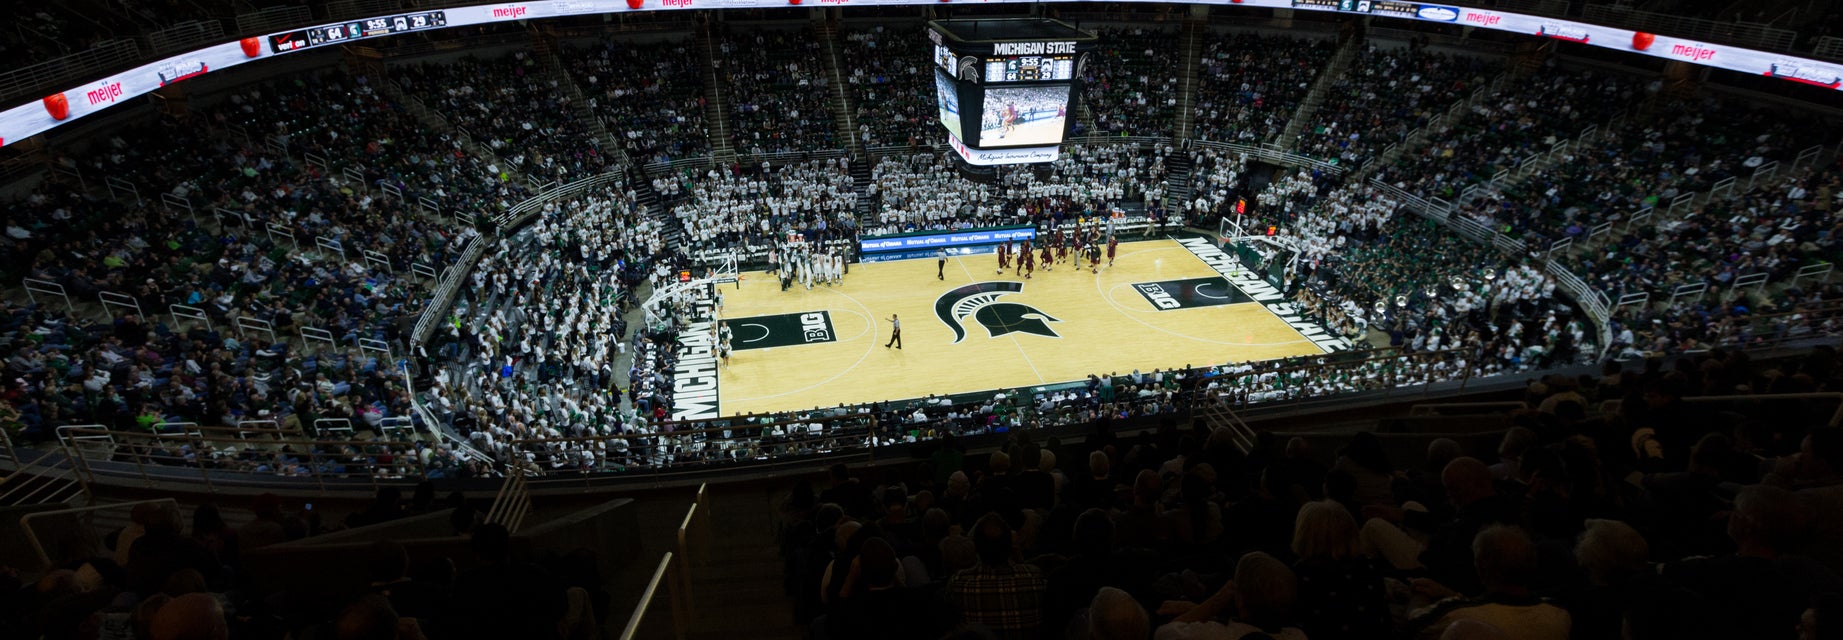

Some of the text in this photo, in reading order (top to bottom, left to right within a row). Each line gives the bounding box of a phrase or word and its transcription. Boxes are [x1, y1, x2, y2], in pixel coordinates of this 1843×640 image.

[493, 5, 527, 18] meijer
[1465, 11, 1501, 25] meijer
[367, 18, 387, 30] 9:55
[412, 16, 426, 27] 29
[327, 28, 342, 40] 64
[278, 39, 306, 51] verizon
[994, 42, 1077, 55] MICHIGAN STATE
[1671, 43, 1716, 60] meijer
[1021, 58, 1039, 66] 9:55
[1042, 71, 1051, 79] 29
[87, 81, 122, 105] meijer
[1178, 236, 1352, 354] MICHIGAN STATE
[671, 323, 718, 421] MICHIGAN
